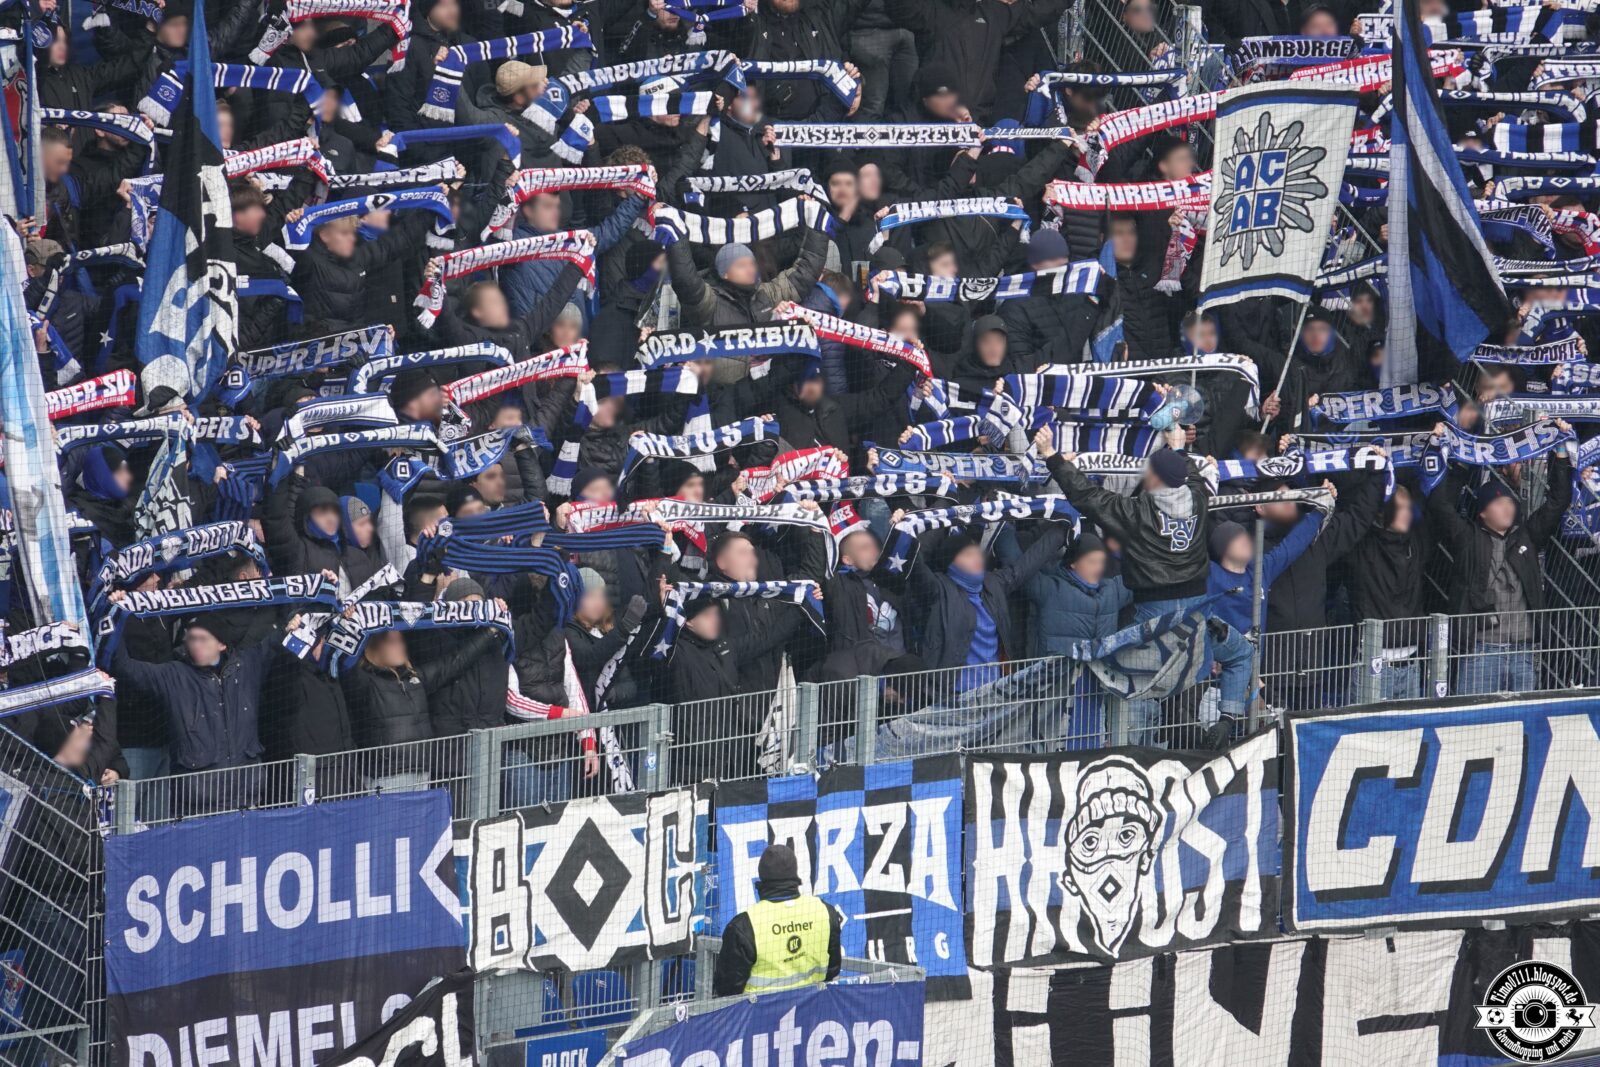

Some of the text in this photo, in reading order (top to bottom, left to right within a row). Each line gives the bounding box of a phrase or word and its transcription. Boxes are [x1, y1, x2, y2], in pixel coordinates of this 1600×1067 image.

[561, 52, 697, 94] HAMBURGER
[781, 126, 974, 144] UNSER VEREIN
[521, 166, 641, 196] HAMBURGER
[295, 202, 359, 236] HAMBURGER
[447, 232, 569, 277] HAMBURGER
[237, 347, 308, 376] SUPER
[635, 333, 696, 369] NORD
[102, 370, 131, 398] SV
[901, 450, 993, 477] SUPER
[117, 573, 324, 612] HAMBURGER SV
[328, 602, 394, 656] BANDA
[720, 796, 958, 913] FORZA
[124, 838, 411, 953] SCHOLLI
[772, 921, 813, 935] Ordner
